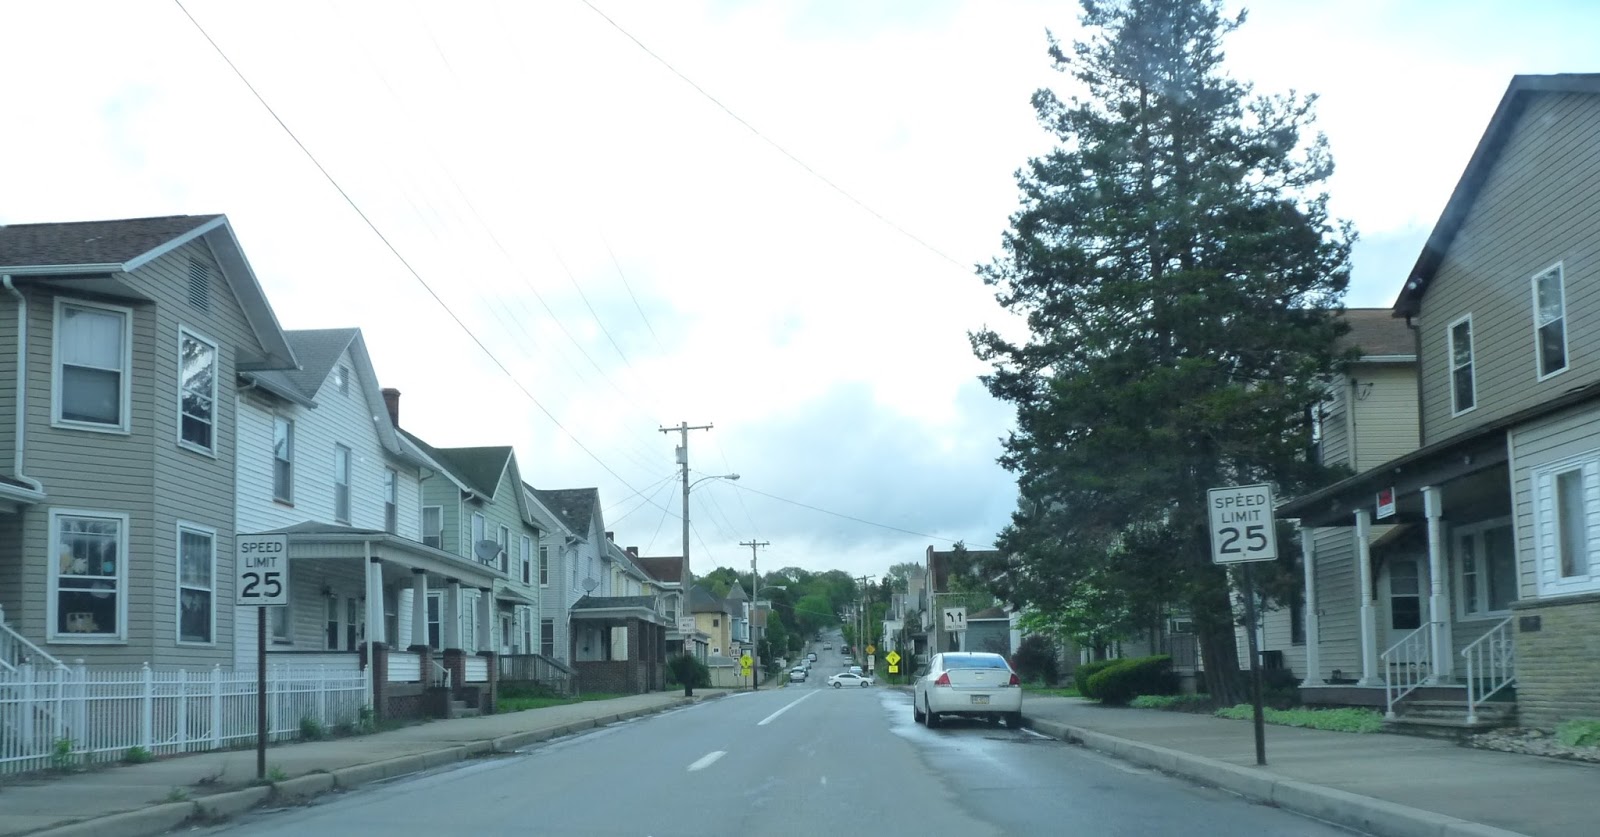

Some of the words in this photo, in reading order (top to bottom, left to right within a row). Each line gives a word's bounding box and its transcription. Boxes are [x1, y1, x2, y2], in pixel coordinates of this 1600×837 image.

[1215, 494, 1266, 508] SPEED
[1221, 510, 1261, 523] LIMIT
[1218, 524, 1267, 554] 25
[241, 541, 283, 553] SPEED
[246, 556, 277, 568] LIMIT
[241, 572, 282, 597] 25
